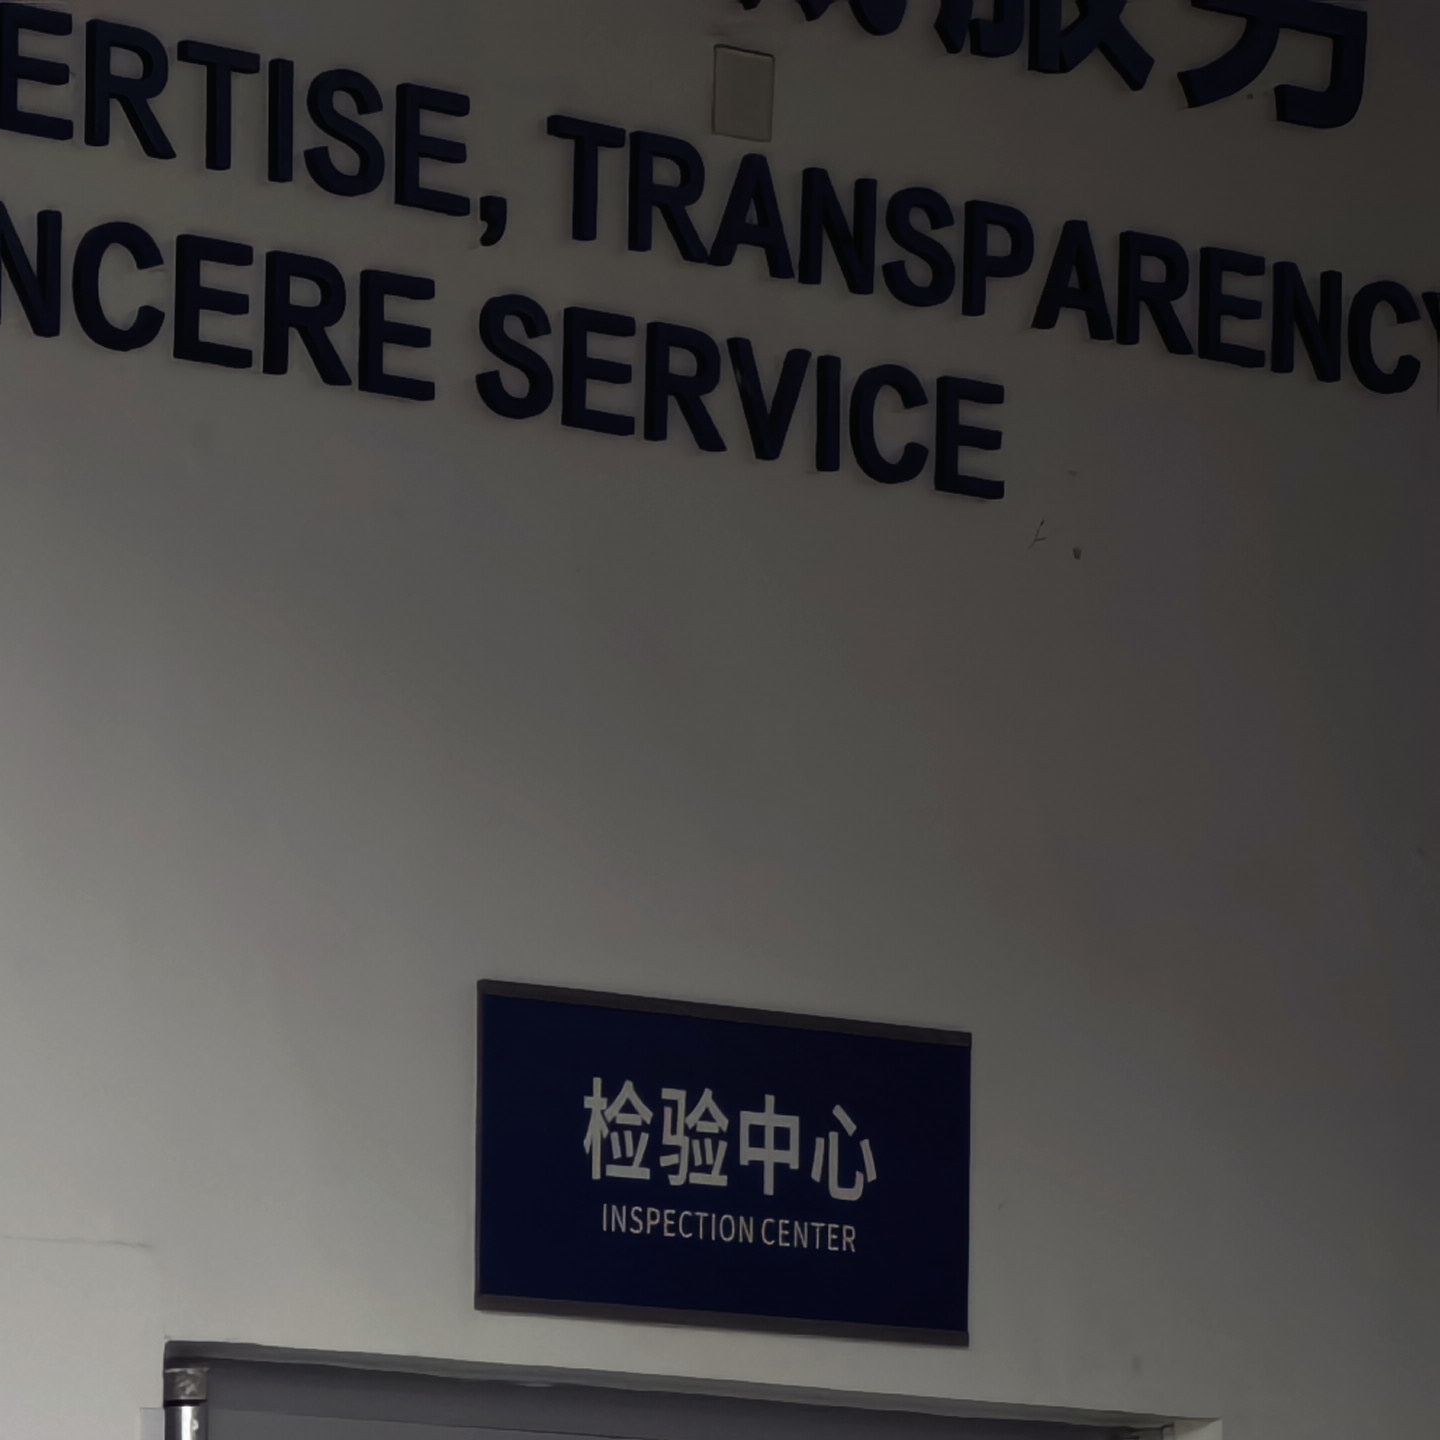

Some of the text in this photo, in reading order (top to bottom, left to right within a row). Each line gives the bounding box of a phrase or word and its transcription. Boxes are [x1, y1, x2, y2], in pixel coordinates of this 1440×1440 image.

[546, 113, 1440, 394] TRANSPARENC
[475, 293, 1006, 501] SERVICE
[583, 1077, 877, 1201] 检验中心
[602, 1203, 856, 1253] INSPECTION CENTER
